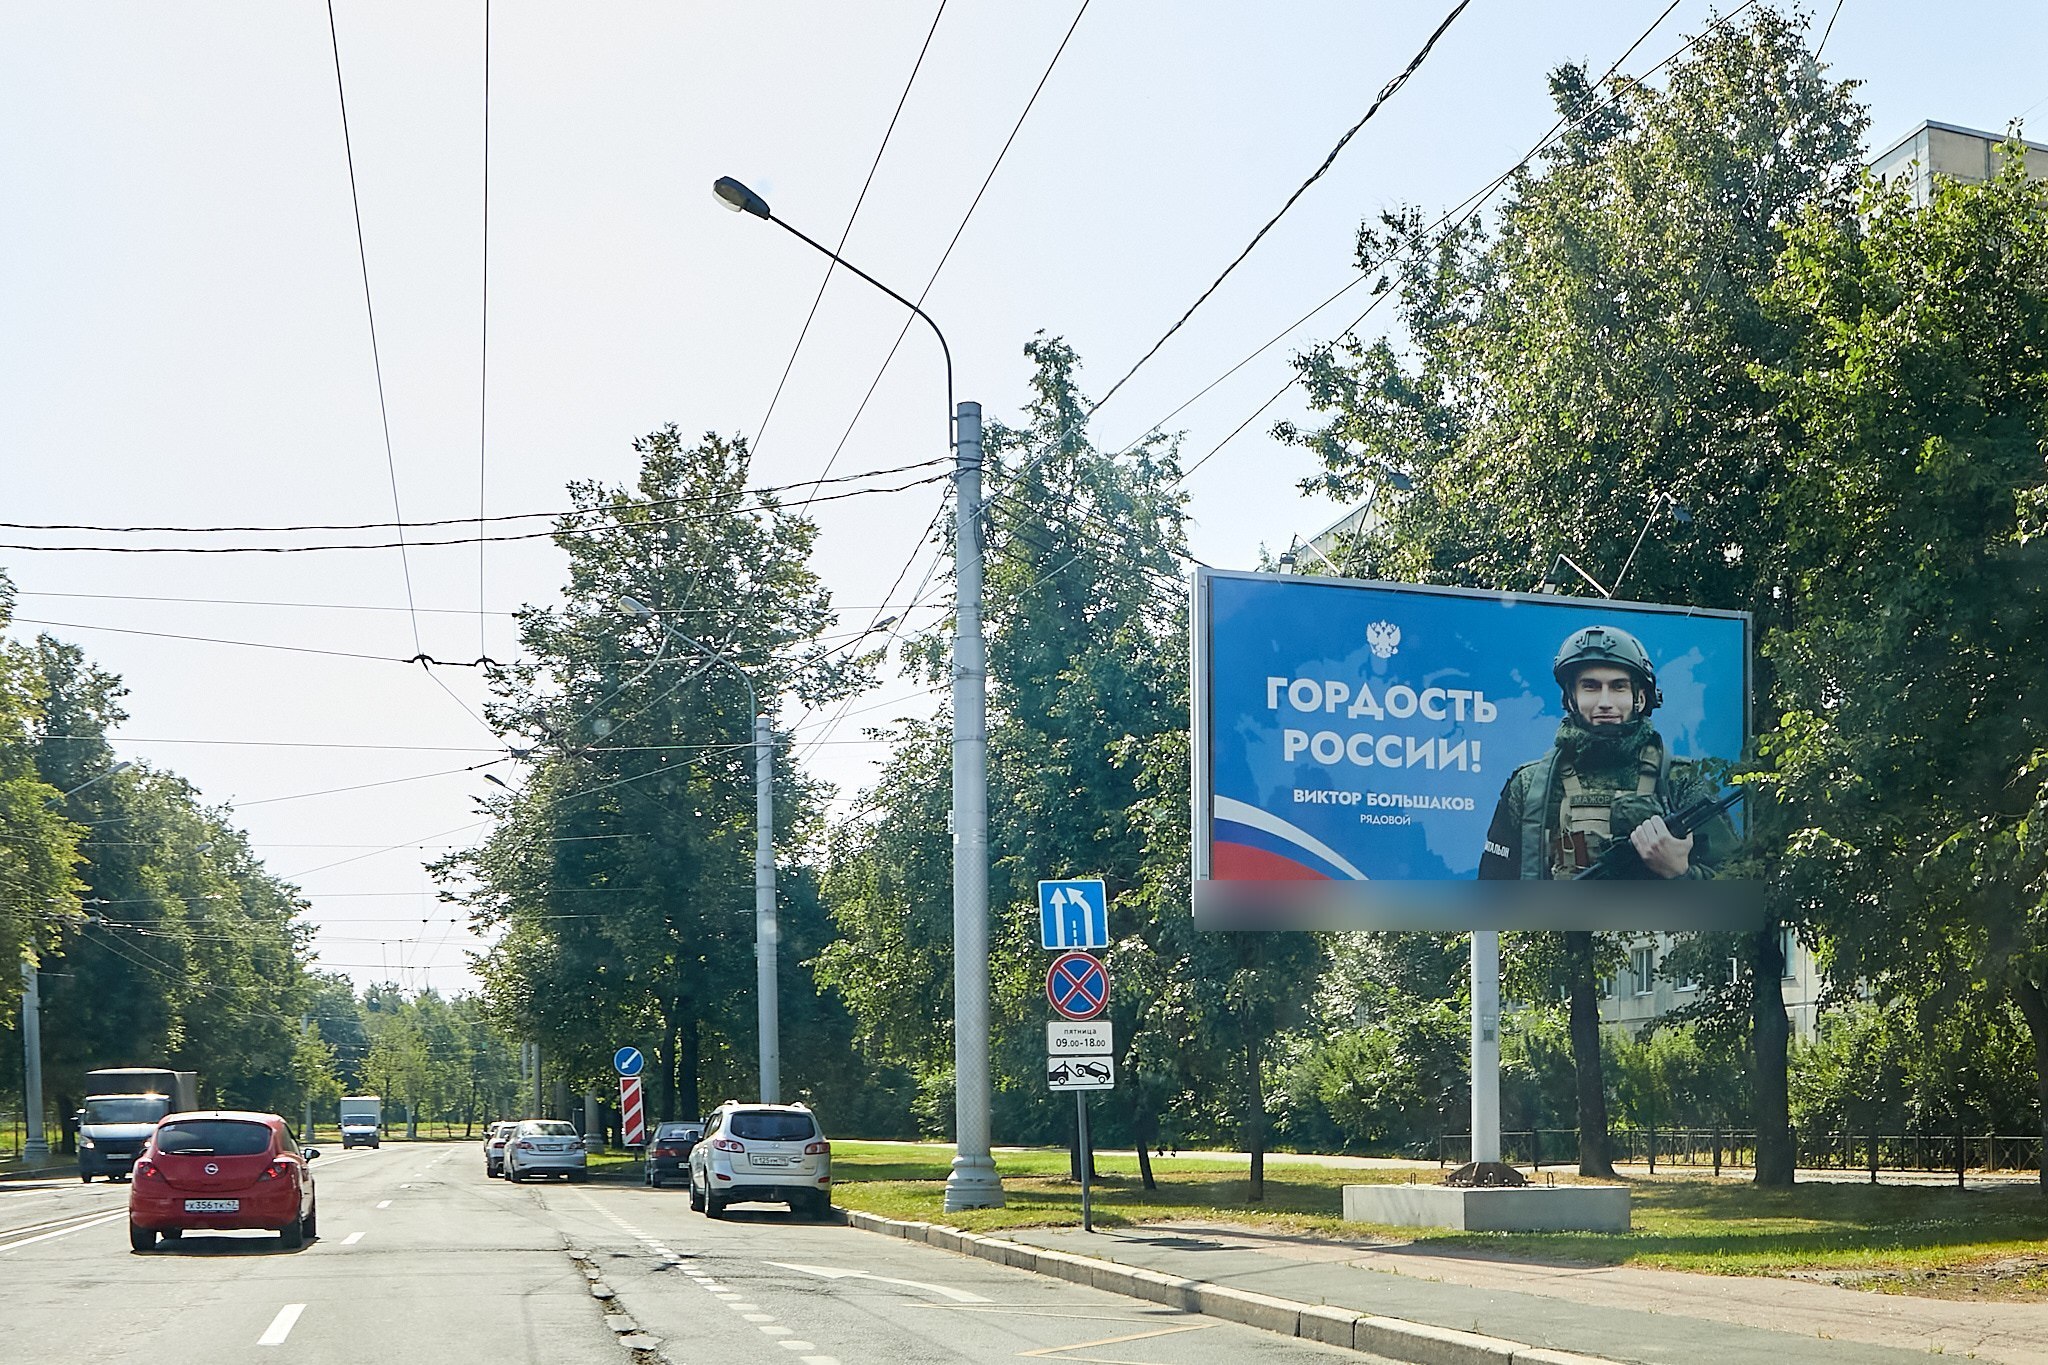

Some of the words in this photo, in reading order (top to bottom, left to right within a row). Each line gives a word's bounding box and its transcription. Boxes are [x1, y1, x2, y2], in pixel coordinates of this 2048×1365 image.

[1267, 676, 1498, 723] ГОРДОСТЬ
[1283, 728, 1482, 773] РОССИИ!
[1293, 789, 1362, 806] ВИКТОР
[1367, 792, 1475, 811] БОЛЬШАКОВ
[1574, 795, 1611, 804] МАЖОР
[1360, 813, 1411, 826] РЯДОВОЙ
[1056, 1038, 1106, 1047] 09.00-18.00
